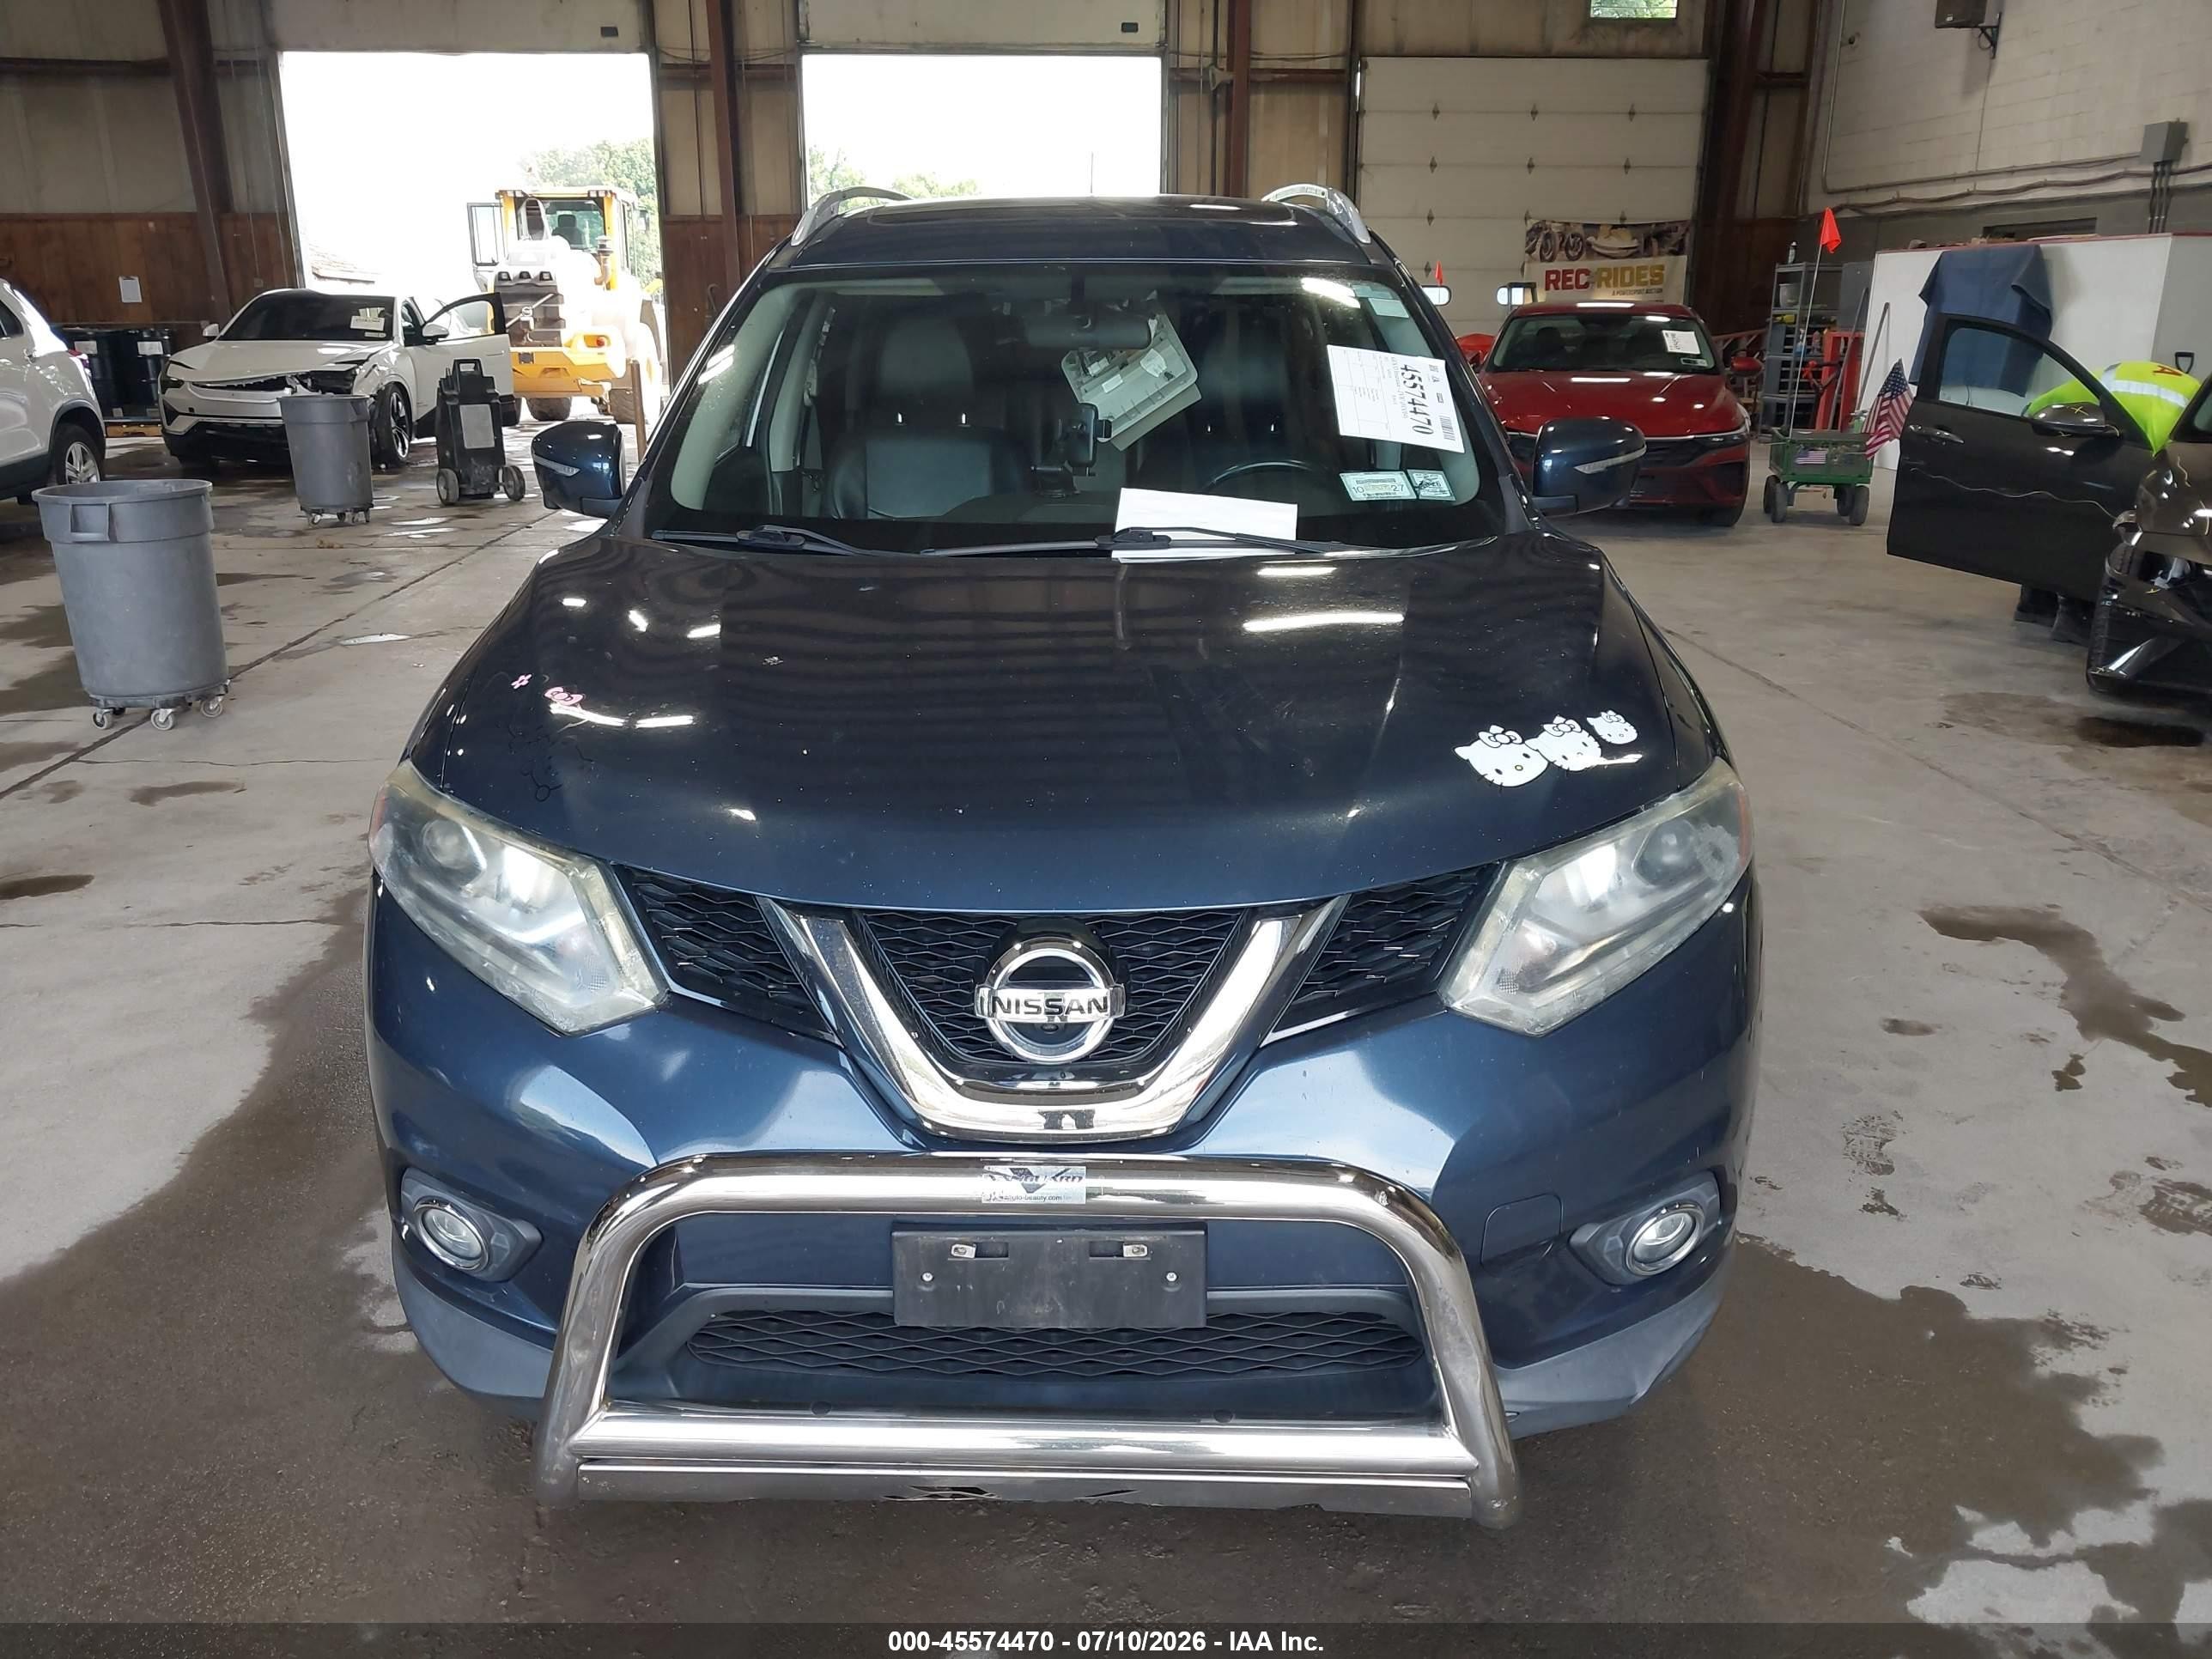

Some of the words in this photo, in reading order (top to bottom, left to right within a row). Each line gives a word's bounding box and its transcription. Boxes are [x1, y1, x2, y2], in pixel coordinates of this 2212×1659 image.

[1545, 268, 1591, 291] REC
[1596, 264, 1665, 289] RIDES
[1401, 364, 1434, 434] 45574470
[992, 996, 1109, 1016] NISSAN
